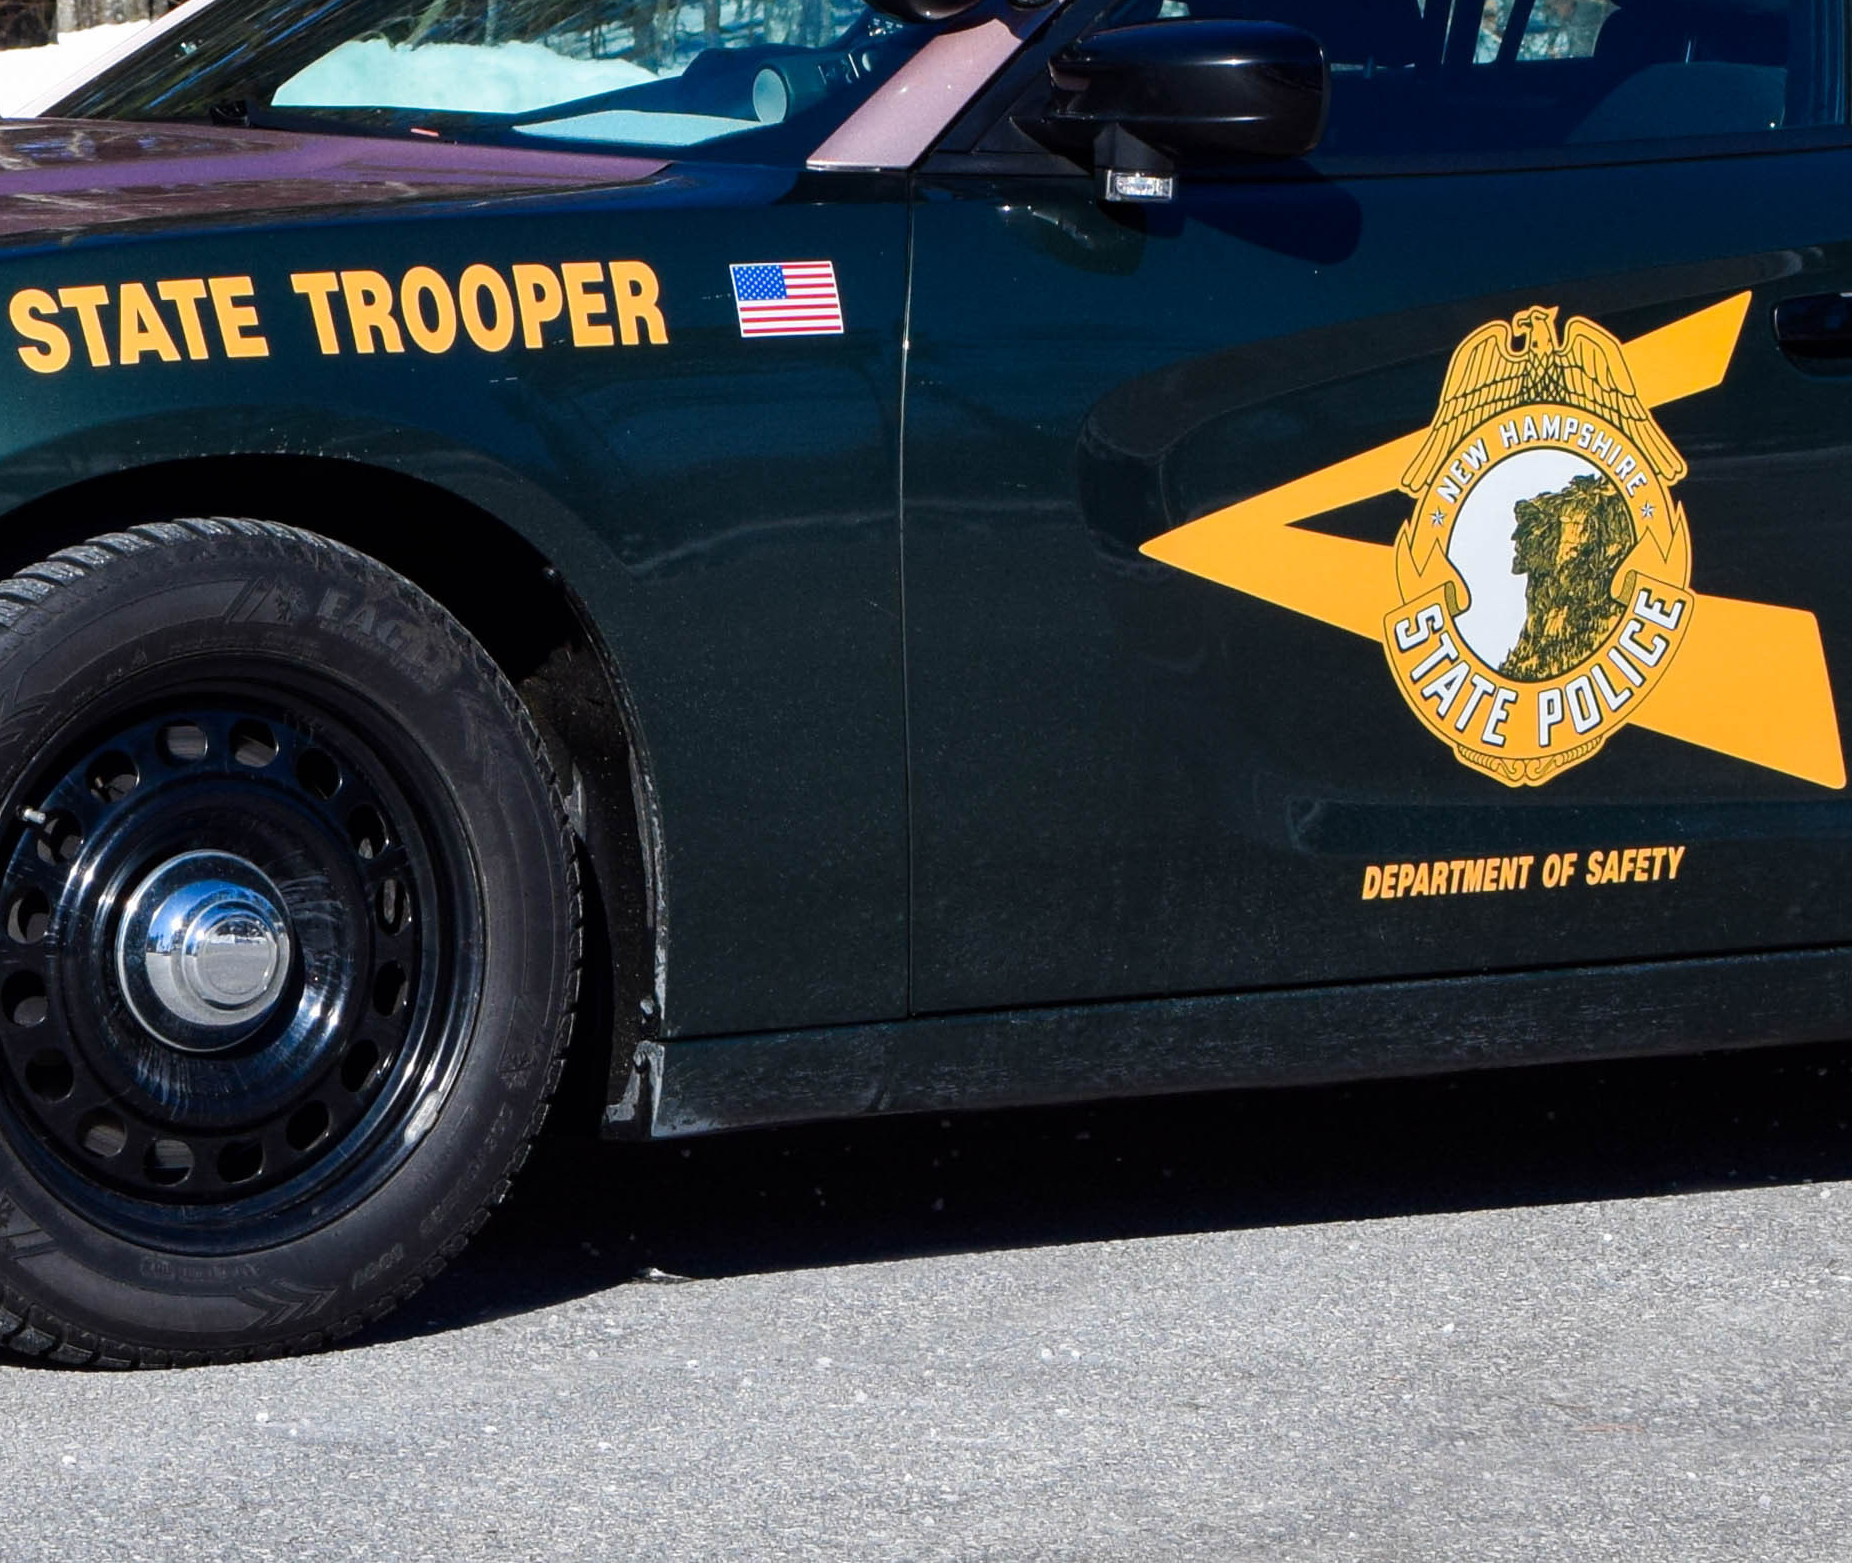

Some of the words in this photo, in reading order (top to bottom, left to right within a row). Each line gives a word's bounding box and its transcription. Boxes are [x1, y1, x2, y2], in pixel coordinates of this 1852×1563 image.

[9, 275, 269, 374] STATE
[290, 260, 669, 354] TROOPER
[1436, 438, 1489, 504] NEW
[1499, 414, 1648, 497] HAMPSHIRE
[1394, 603, 1518, 747] STATE
[1538, 587, 1687, 747] POLICE
[1361, 855, 1534, 900] DEPARTMENT
[1541, 852, 1578, 888] OF
[1585, 846, 1685, 886] SAFETY
